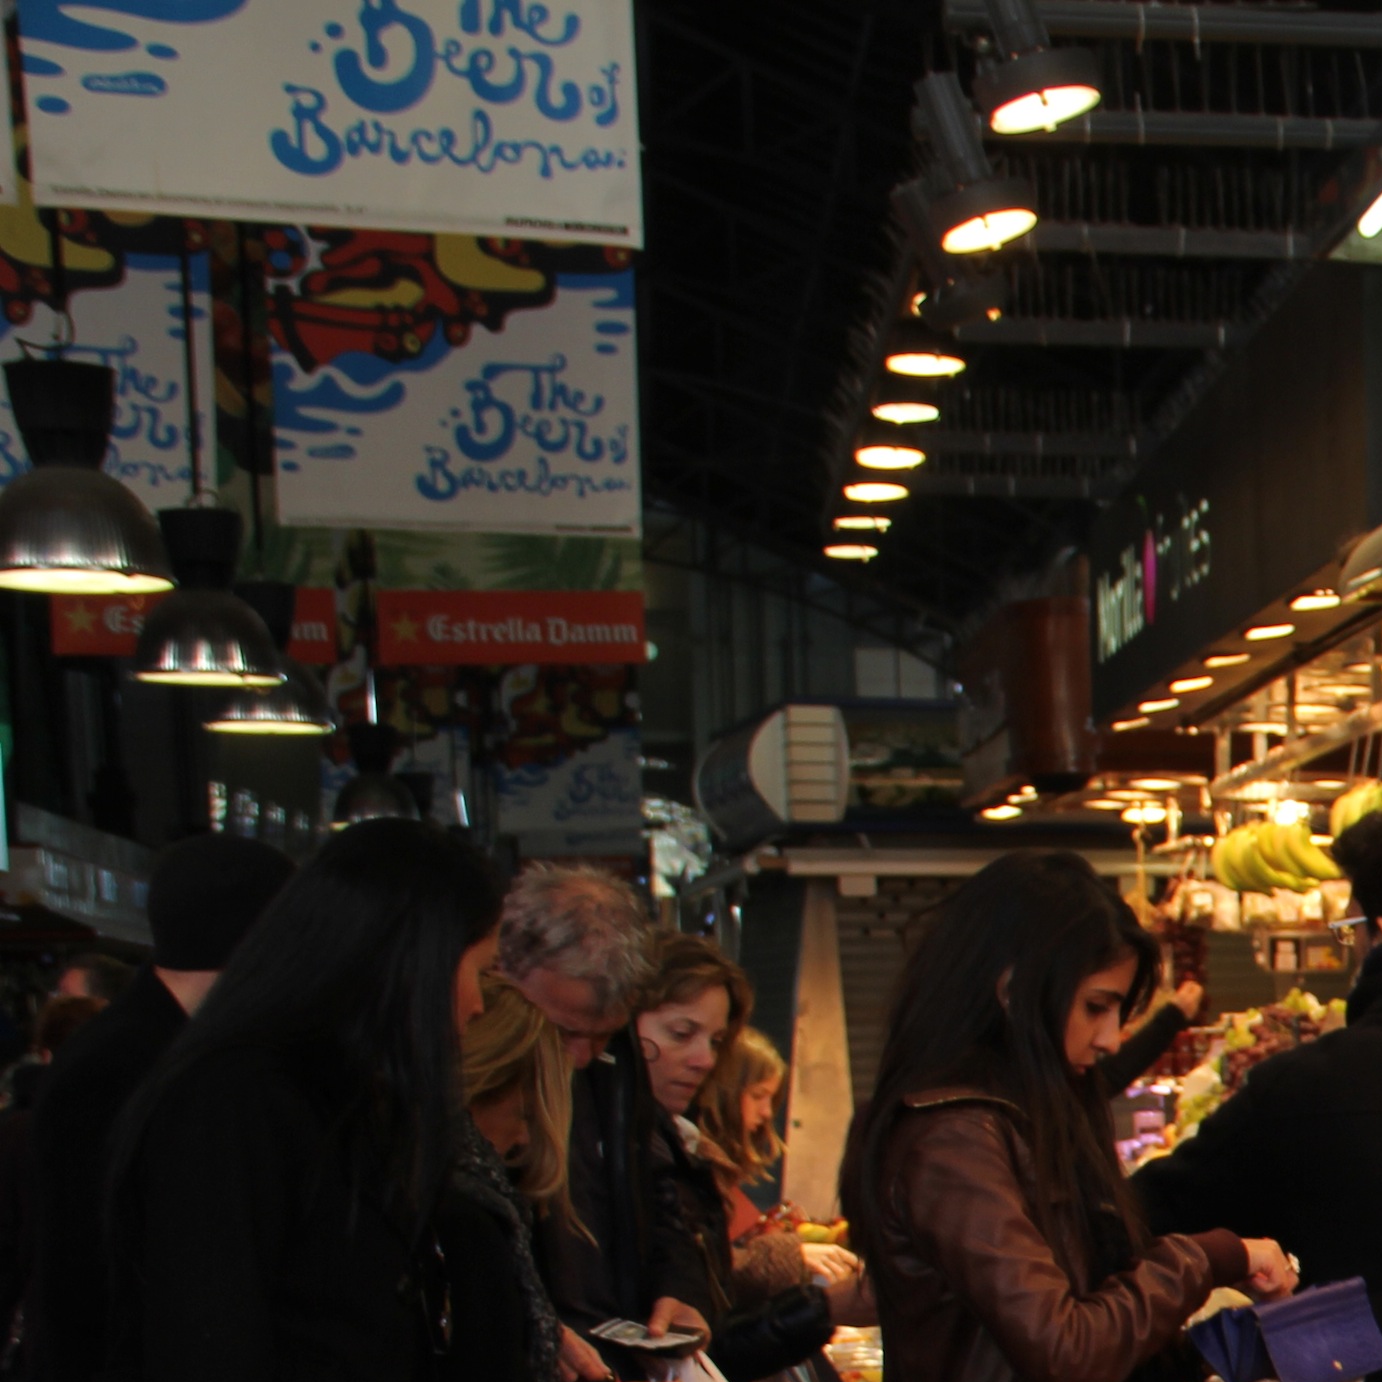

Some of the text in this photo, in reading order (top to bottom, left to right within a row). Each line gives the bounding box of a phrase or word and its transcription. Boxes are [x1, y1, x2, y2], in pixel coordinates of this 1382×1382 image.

[334, 0, 621, 127] Beer of
[455, 379, 604, 463] Beer
[482, 353, 605, 416] The
[426, 613, 639, 646] Estrella Damm
